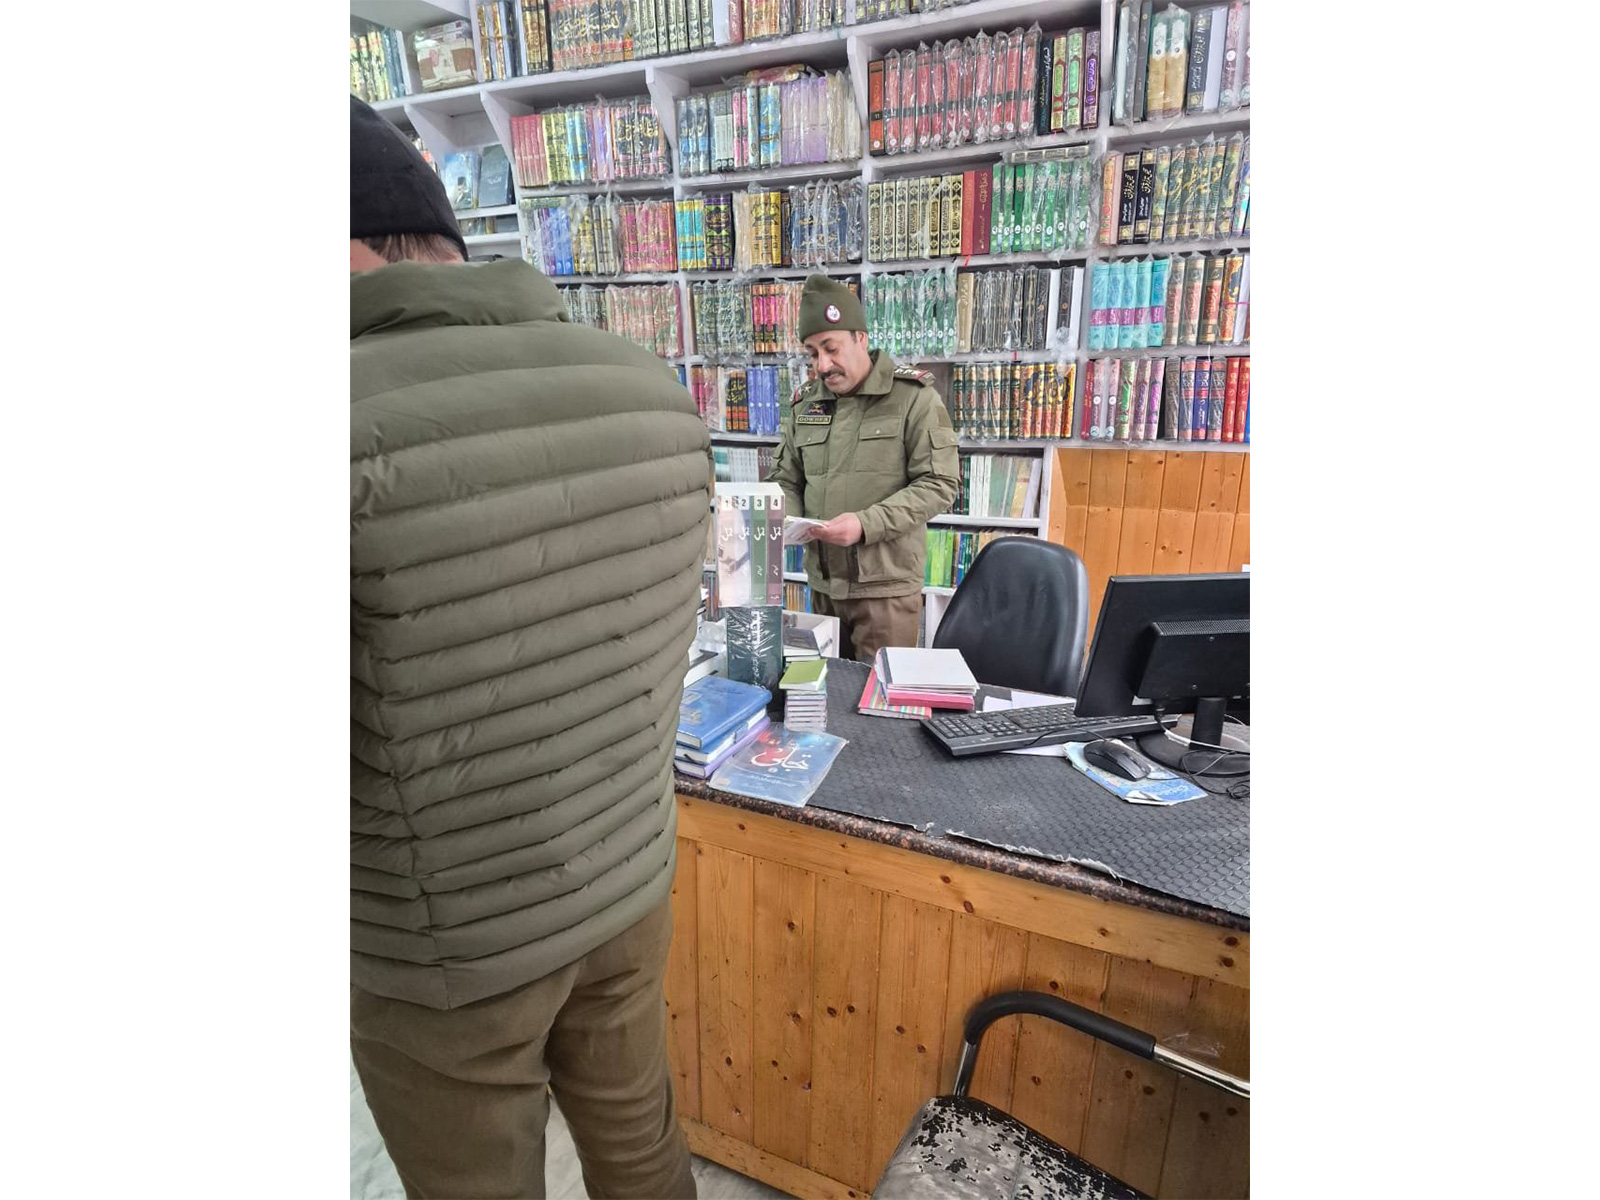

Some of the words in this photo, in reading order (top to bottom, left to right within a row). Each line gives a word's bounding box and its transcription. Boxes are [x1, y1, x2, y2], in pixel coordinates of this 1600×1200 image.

[741, 499, 747, 507] 2
[756, 499, 762, 507] 3
[773, 499, 779, 507] 4
